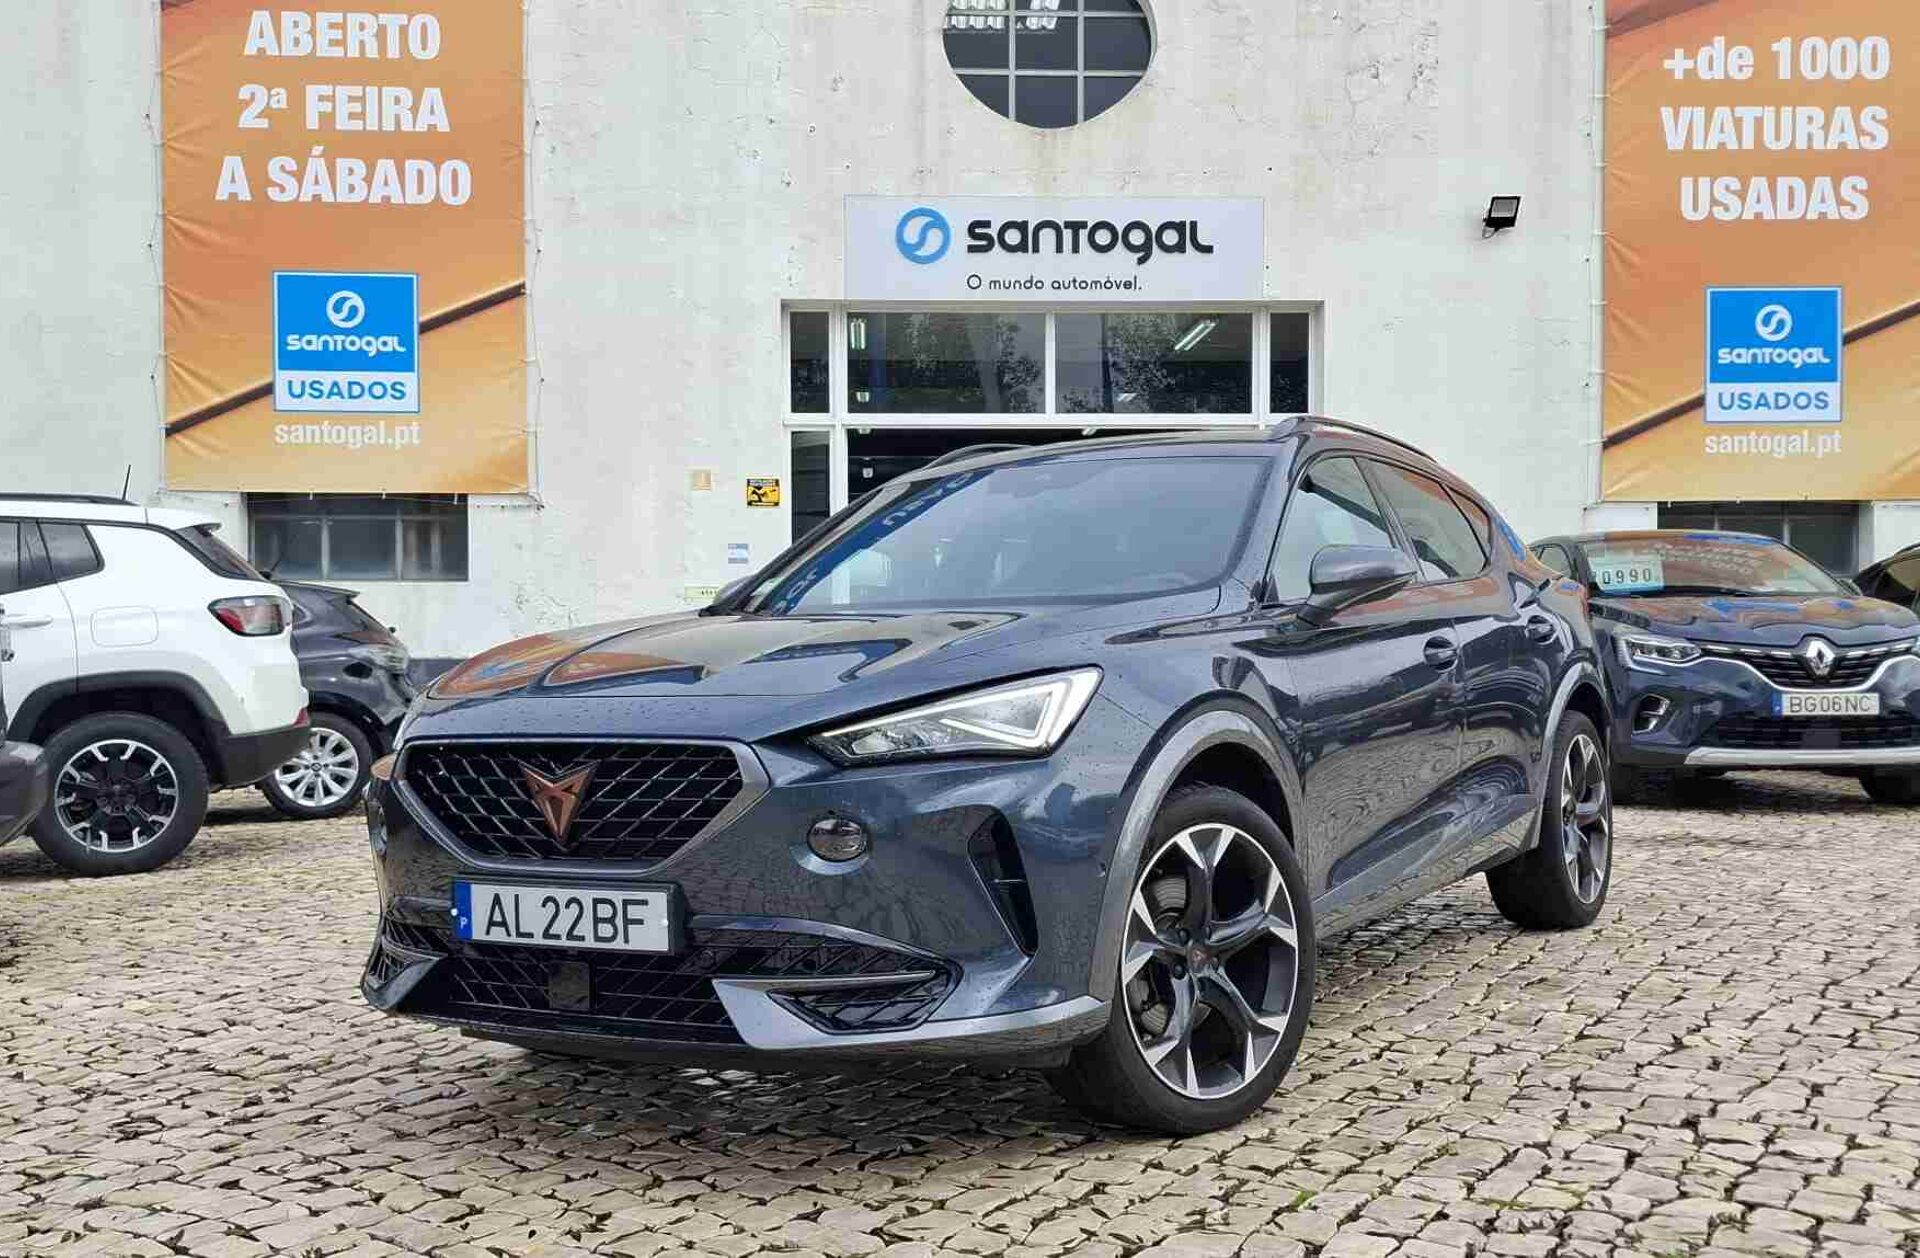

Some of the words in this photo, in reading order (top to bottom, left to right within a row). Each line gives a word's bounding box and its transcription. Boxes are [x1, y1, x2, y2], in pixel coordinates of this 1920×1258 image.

[243, 10, 441, 60] ABERTO
[1662, 36, 1755, 80] +de
[1771, 36, 1890, 81] 1000
[305, 85, 450, 132] FEIRA
[1660, 105, 1889, 151] VIATURAS
[215, 156, 251, 202] A
[266, 146, 472, 206] SÁBADO
[1680, 176, 1870, 221] USADAS
[966, 274, 982, 290] O
[988, 275, 1045, 291] mundo
[1051, 275, 1143, 291] automóvel.
[287, 379, 407, 401] USADOS
[1718, 392, 1830, 411] USADOS
[274, 420, 421, 449] santogal.pt
[1704, 429, 1843, 458] santogal.pt
[1789, 695, 1871, 713] BG06NC
[485, 892, 649, 944] AL22BF
